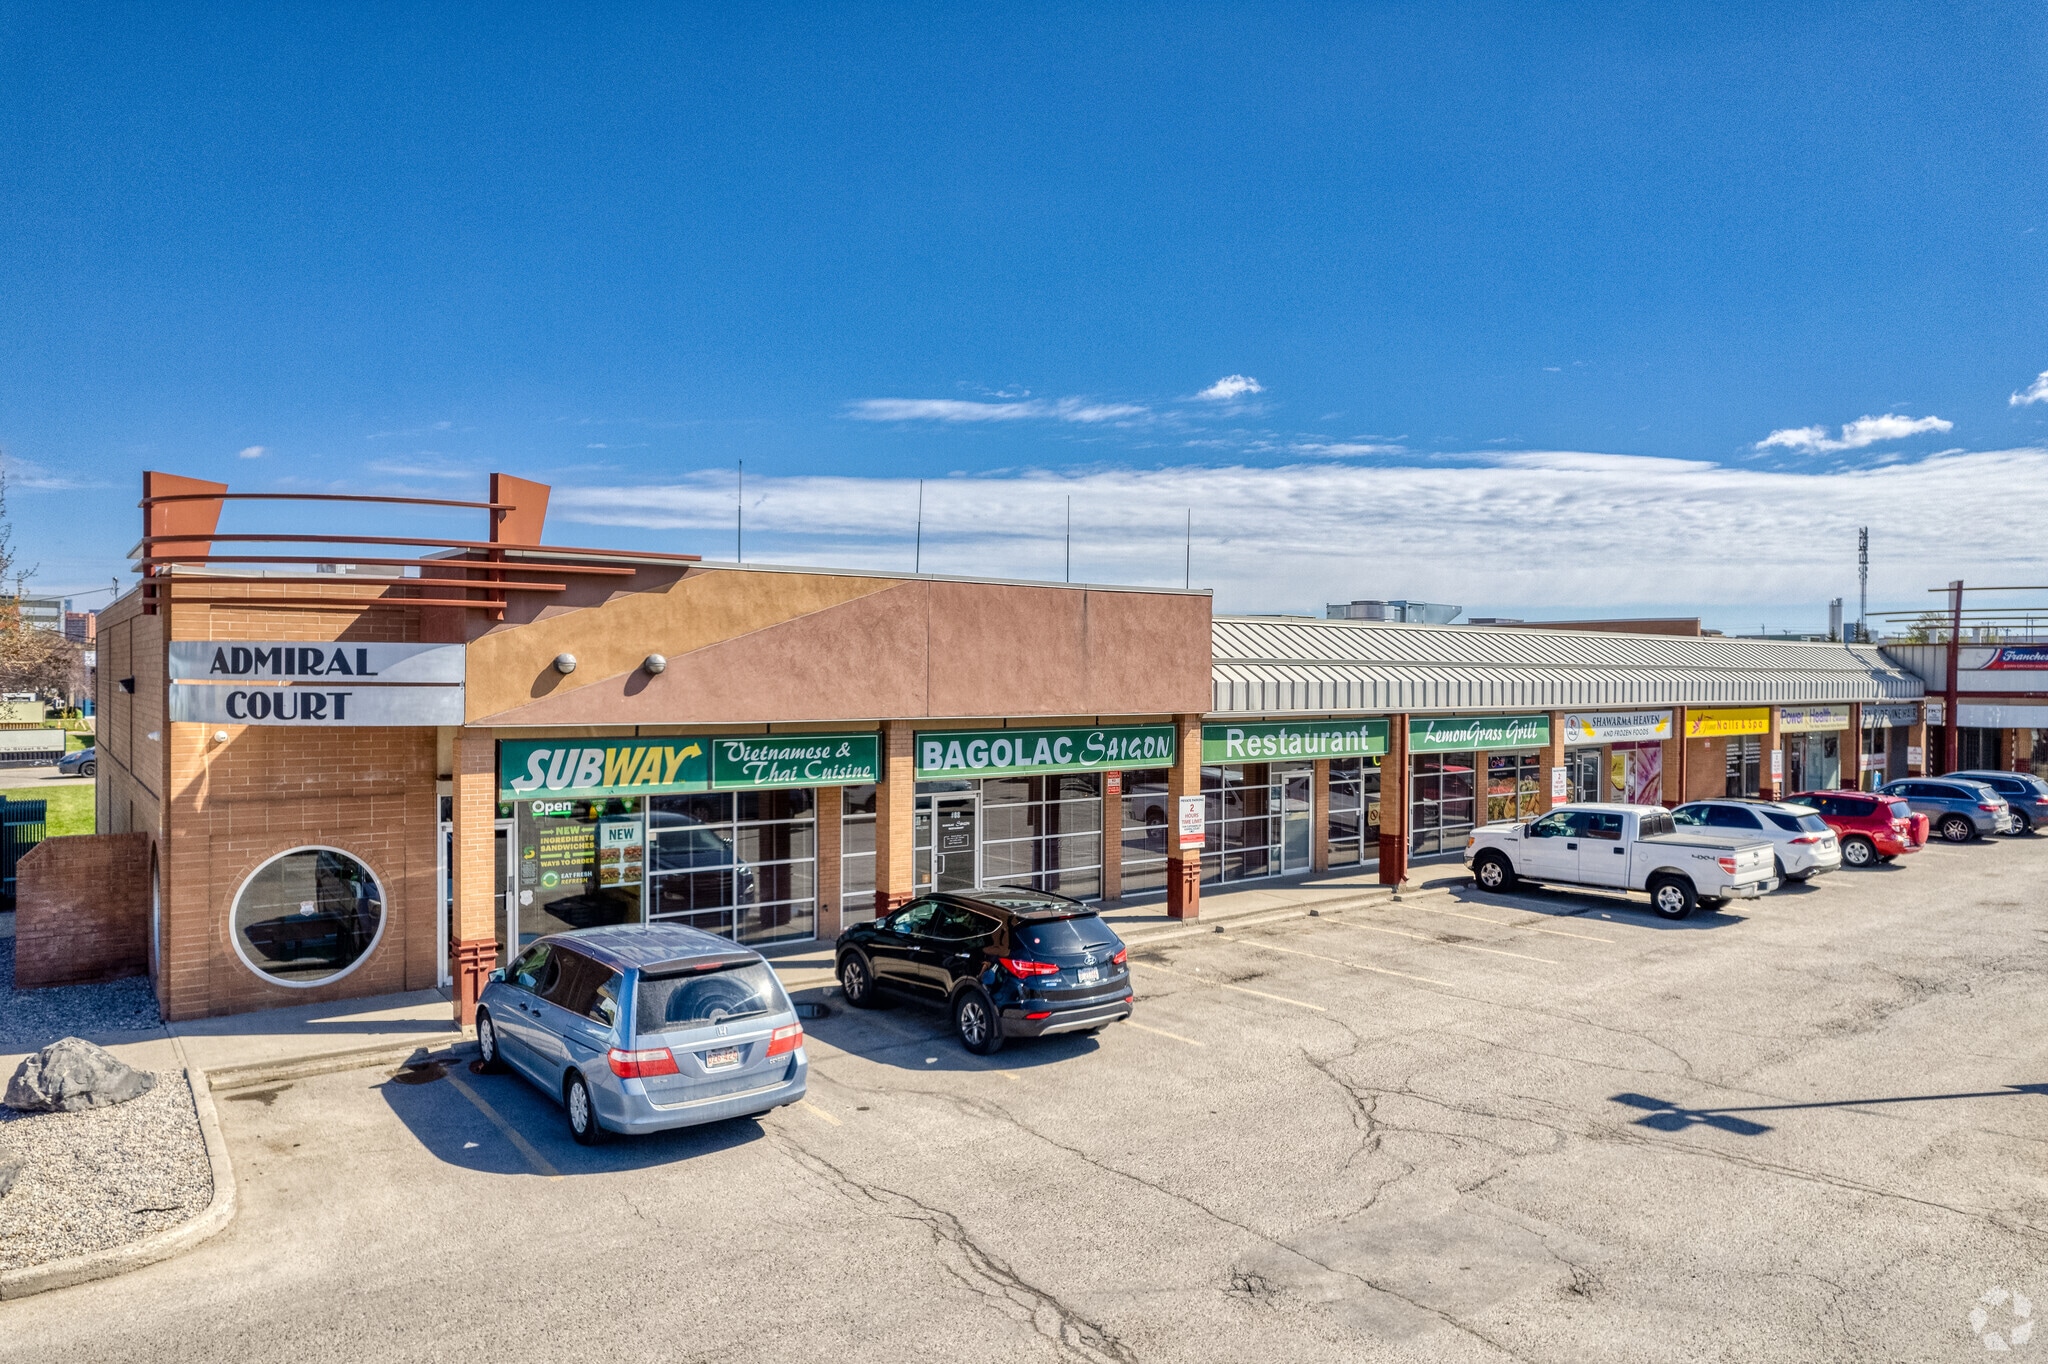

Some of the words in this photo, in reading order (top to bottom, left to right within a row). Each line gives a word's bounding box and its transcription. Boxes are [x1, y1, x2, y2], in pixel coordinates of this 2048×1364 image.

[209, 646, 378, 676] ADMIRAL
[226, 691, 352, 720] COURT
[1592, 716, 1632, 727] SHAWARMA
[1633, 714, 1660, 725] HEAVEN
[1781, 709, 1804, 725] Power
[1810, 707, 1832, 722] Health
[1424, 720, 1503, 747] LemonGrass
[1505, 719, 1538, 745] Grill
[1603, 730, 1613, 738] AND
[1614, 729, 1631, 737] FROZEN
[1633, 728, 1649, 736] FOODS
[1226, 725, 1369, 758] Restaurant
[723, 741, 831, 762] Vietnamese
[835, 741, 851, 758] &
[923, 736, 1073, 771] BAGOLAC
[510, 742, 702, 796] SUBWAY
[742, 761, 798, 784] Thai
[804, 760, 871, 780] Cuisine
[532, 800, 572, 816] Open
[1189, 803, 1195, 812] 2
[541, 834, 595, 844] INGREDIENTS
[555, 826, 580, 836] NEW
[609, 828, 634, 841] NEW
[541, 842, 595, 852] SANDWICHES
[563, 851, 571, 859] &
[541, 860, 560, 868] WAYS
